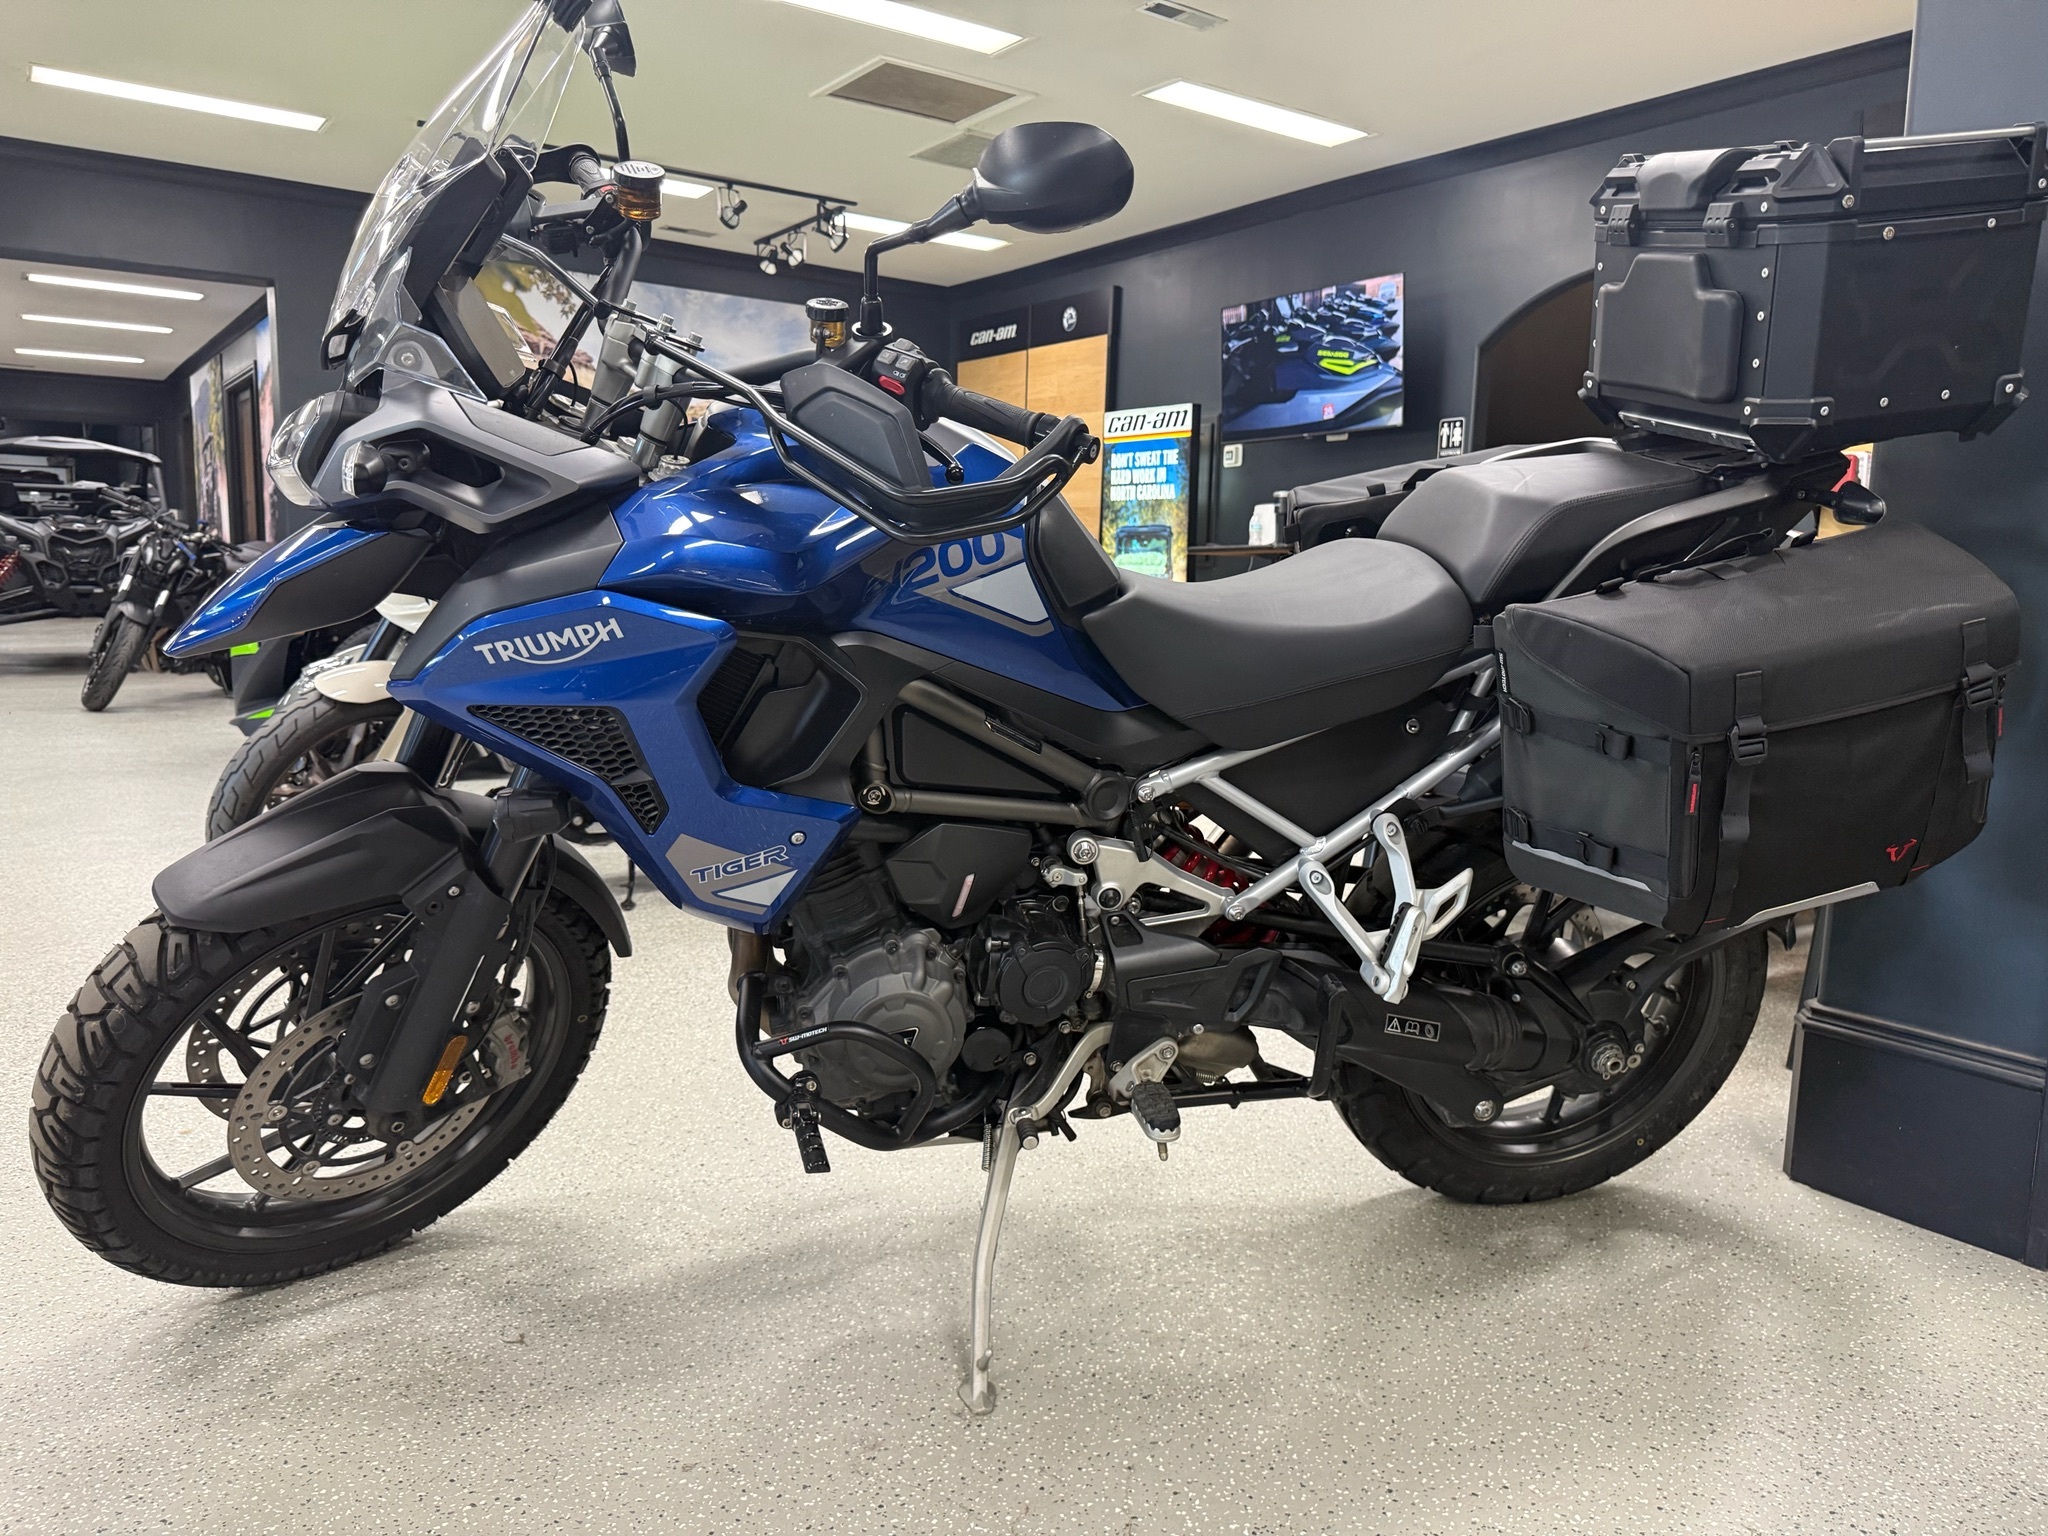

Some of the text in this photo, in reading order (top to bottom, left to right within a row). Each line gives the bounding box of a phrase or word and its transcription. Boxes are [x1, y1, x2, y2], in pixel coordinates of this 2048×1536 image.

[970, 324, 1017, 346] can-am
[1108, 410, 1188, 433] can-am
[1111, 448, 1179, 469] DON'T SWEAT THE
[1110, 466, 1167, 485] HARD WORK IN
[1110, 483, 1176, 502] NORTH CAROLINA
[473, 618, 624, 665] TRIUMPH
[690, 845, 789, 883] TIGER
[503, 1033, 520, 1070] brembo
